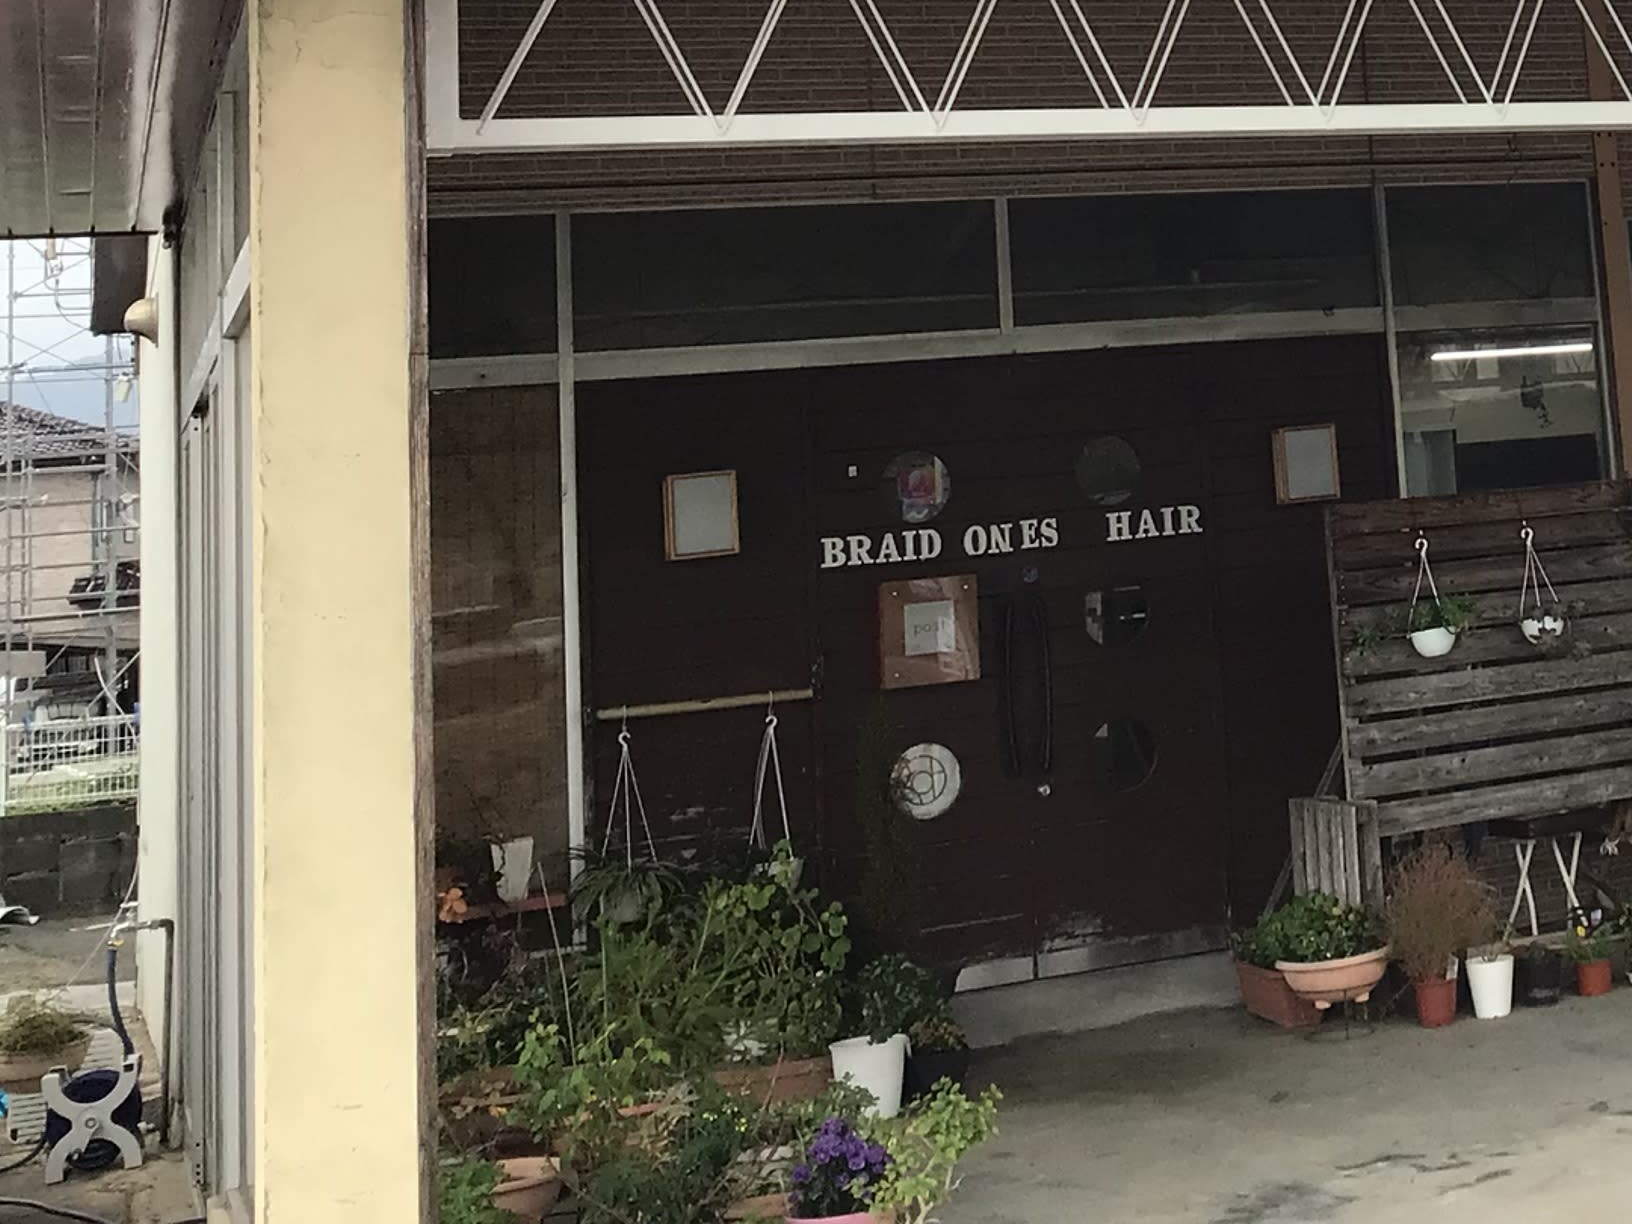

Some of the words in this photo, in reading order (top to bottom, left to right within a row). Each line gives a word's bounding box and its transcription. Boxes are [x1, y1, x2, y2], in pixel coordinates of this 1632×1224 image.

[820, 528, 942, 568] BRAID
[963, 517, 1059, 556] ONES
[1105, 504, 1203, 541] HAIR
